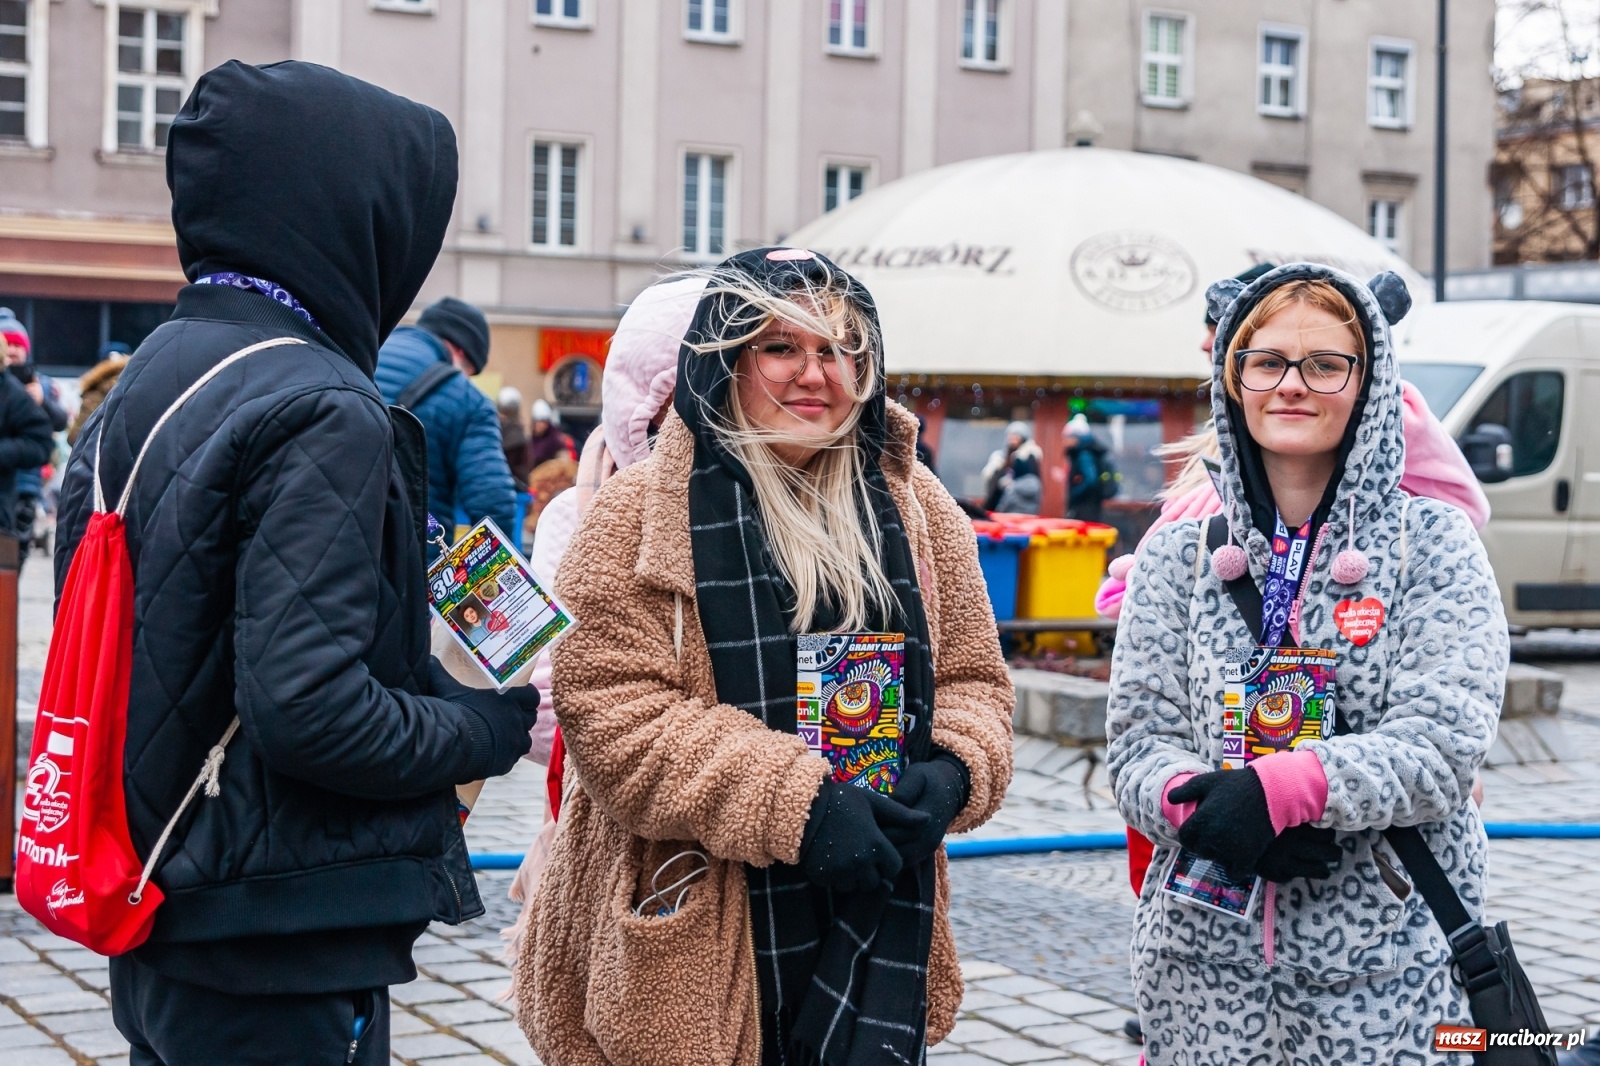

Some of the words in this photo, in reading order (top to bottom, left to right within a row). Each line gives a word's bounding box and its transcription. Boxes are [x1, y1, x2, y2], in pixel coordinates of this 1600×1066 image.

[1289, 543, 1302, 577] PLAY
[432, 566, 456, 601] 30
[849, 643, 880, 651] GRAMY
[881, 643, 897, 651] DLA
[797, 655, 813, 664] net
[1270, 655, 1303, 664] GRAMY
[1304, 656, 1321, 665] DLA
[1225, 667, 1238, 676] net
[797, 706, 815, 716] ank
[1224, 716, 1240, 726] ank
[797, 731, 815, 741] AY
[1223, 741, 1239, 751] AY
